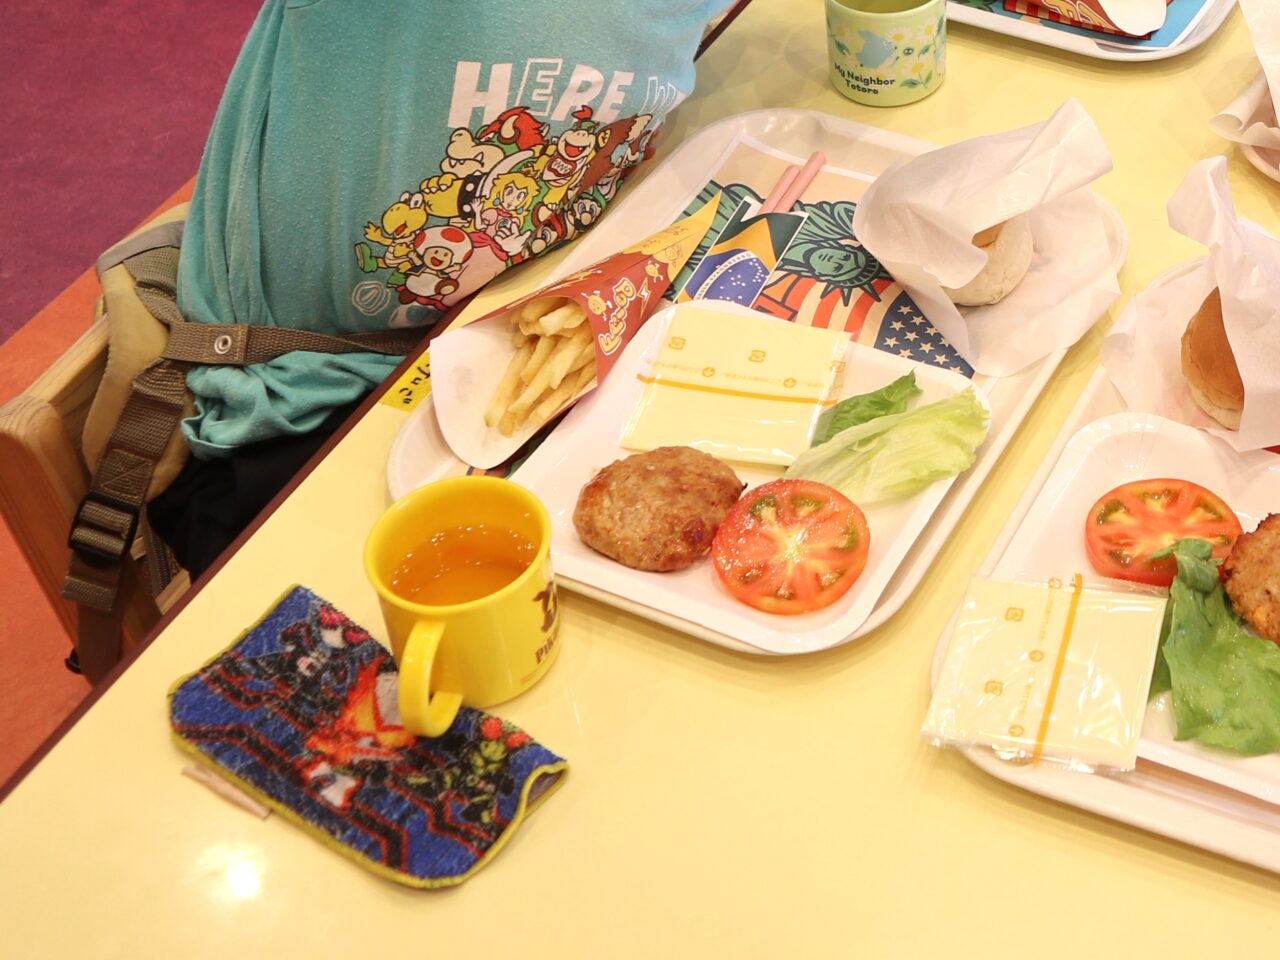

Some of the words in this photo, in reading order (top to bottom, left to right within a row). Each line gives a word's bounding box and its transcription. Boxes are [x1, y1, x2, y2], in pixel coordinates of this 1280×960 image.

[448, 58, 635, 129] HERE
[834, 62, 846, 79] My
[847, 71, 896, 87] Neighbor
[844, 80, 880, 95] Totoro
[598, 277, 636, 355] Fried
